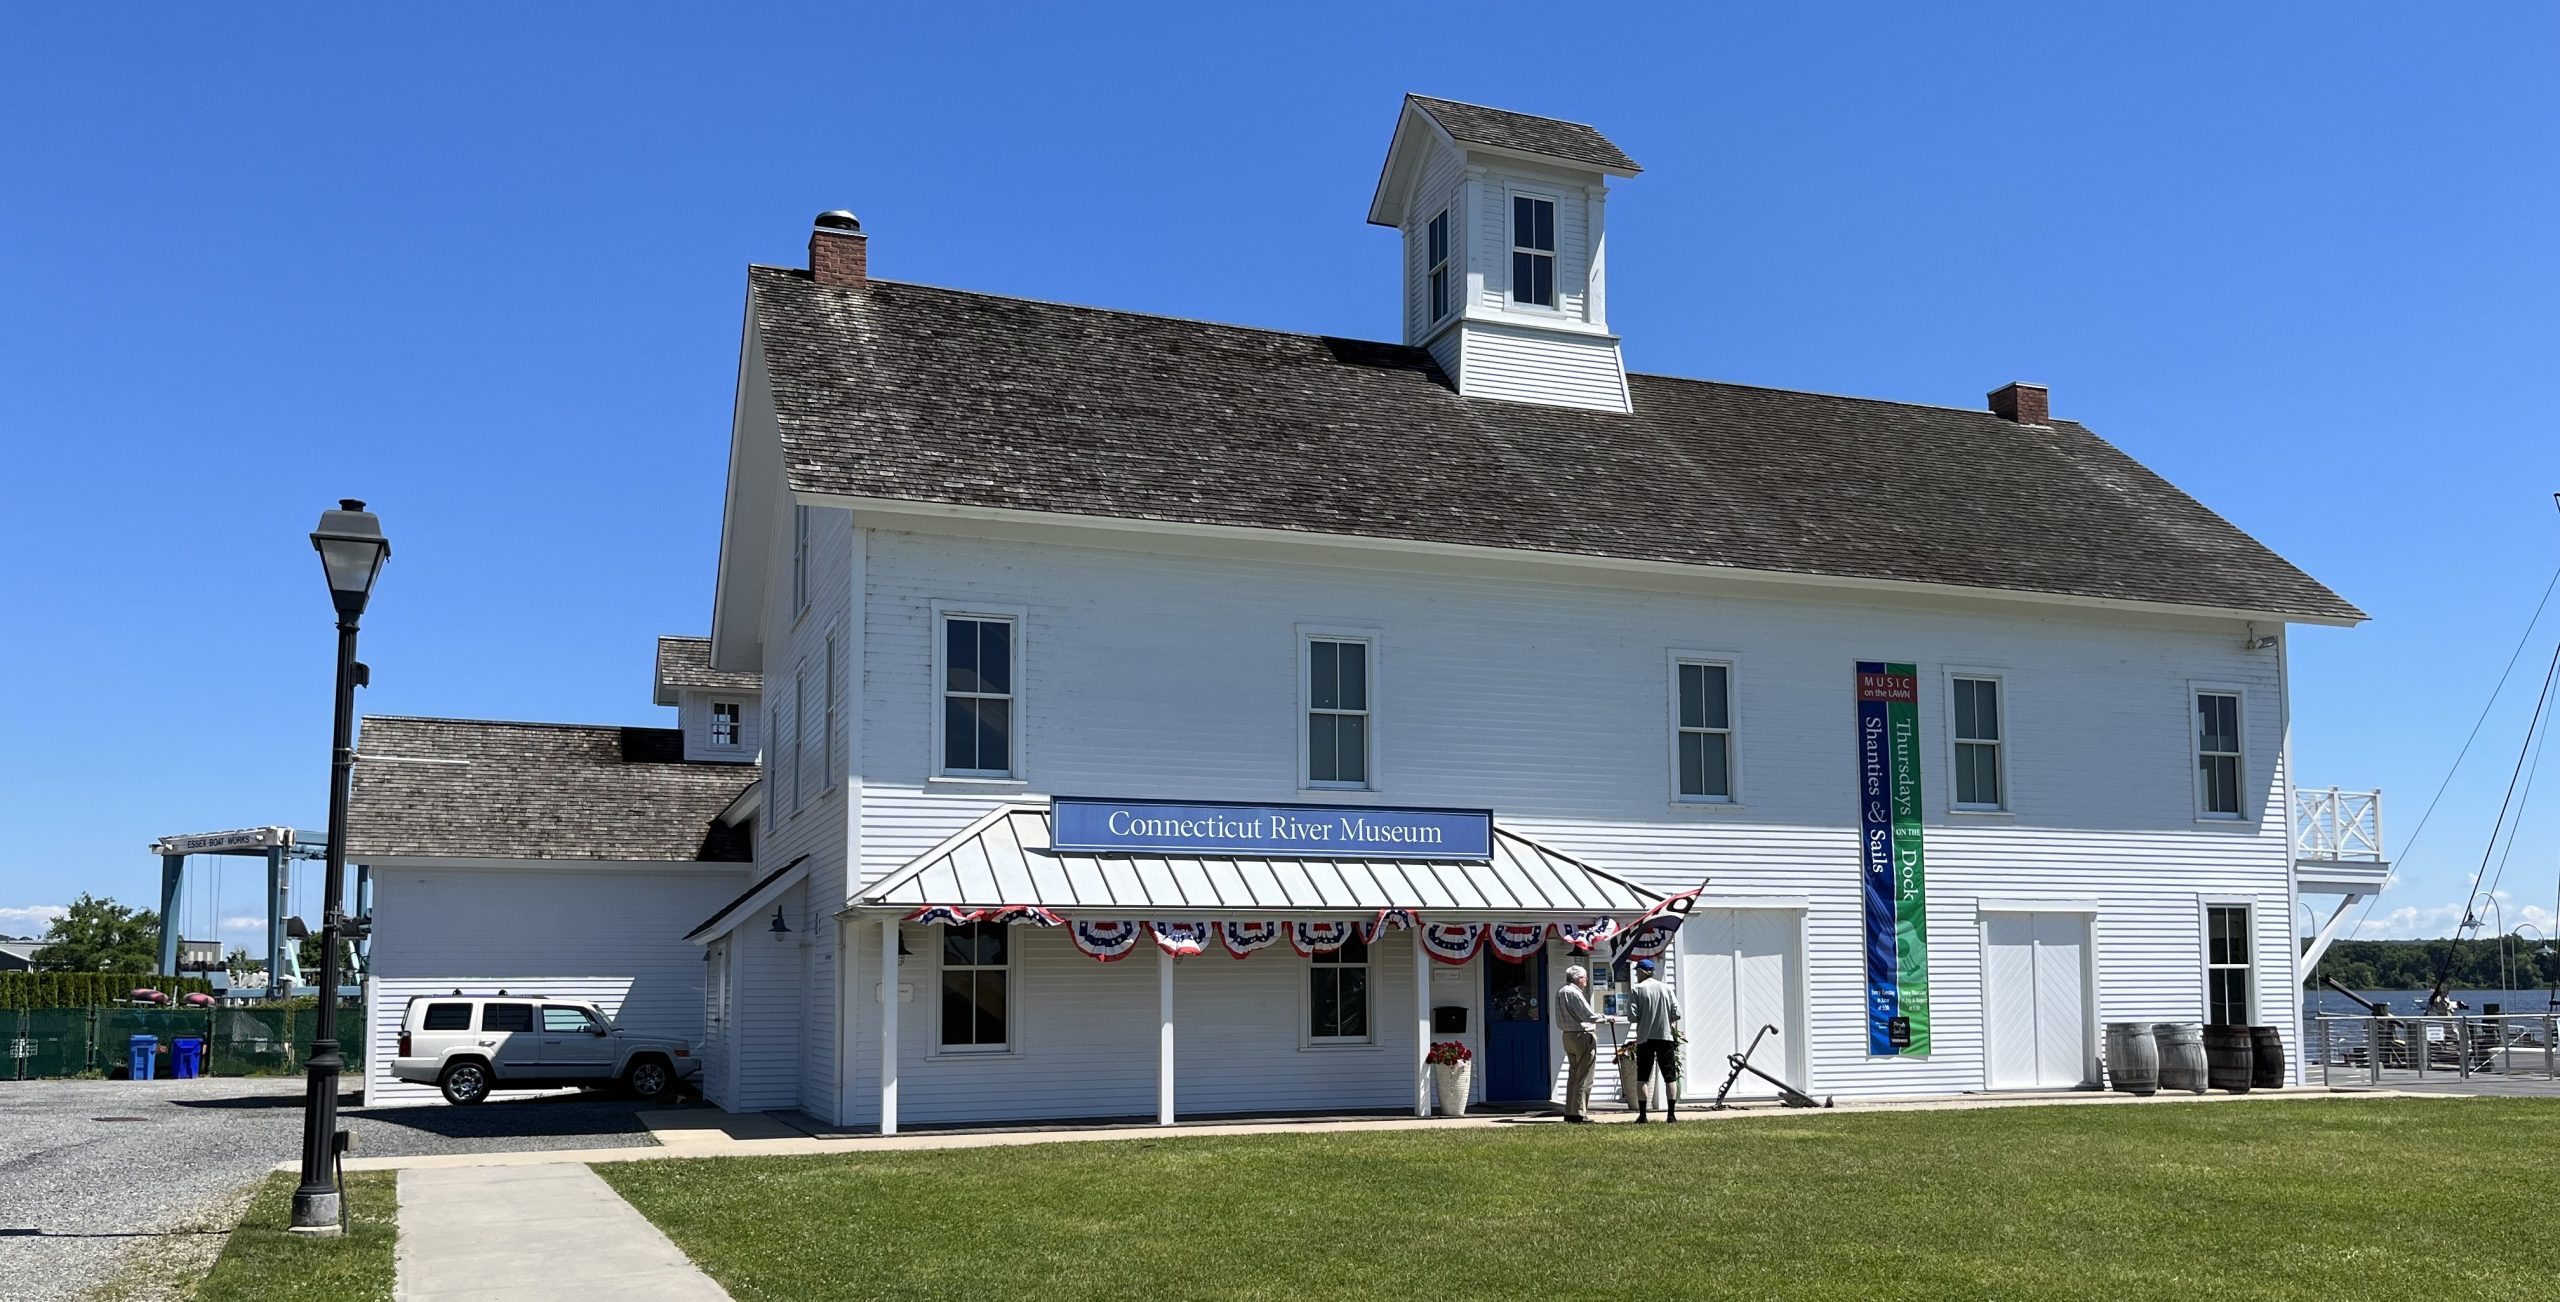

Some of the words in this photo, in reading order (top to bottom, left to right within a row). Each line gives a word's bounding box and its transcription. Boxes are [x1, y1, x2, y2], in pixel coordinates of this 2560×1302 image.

[1864, 676, 1910, 689] MUSIC
[1864, 689, 1874, 697] on
[1875, 689, 1887, 697] the
[1888, 690, 1910, 699] LAWN
[1865, 716, 1883, 796] Shanties
[1895, 718, 1915, 815] Thursdays
[1867, 801, 1887, 823] &
[1108, 810, 1263, 839] Connecticut
[1269, 815, 1333, 841] River
[1339, 817, 1443, 843] Museum
[1896, 828, 1907, 836] ON
[1908, 828, 1921, 836] THE
[187, 840, 207, 849] ESSEX
[209, 838, 224, 847] BOAT
[228, 835, 250, 845] WORKS
[1870, 829, 1888, 873] Sails
[1901, 848, 1919, 901] Dock
